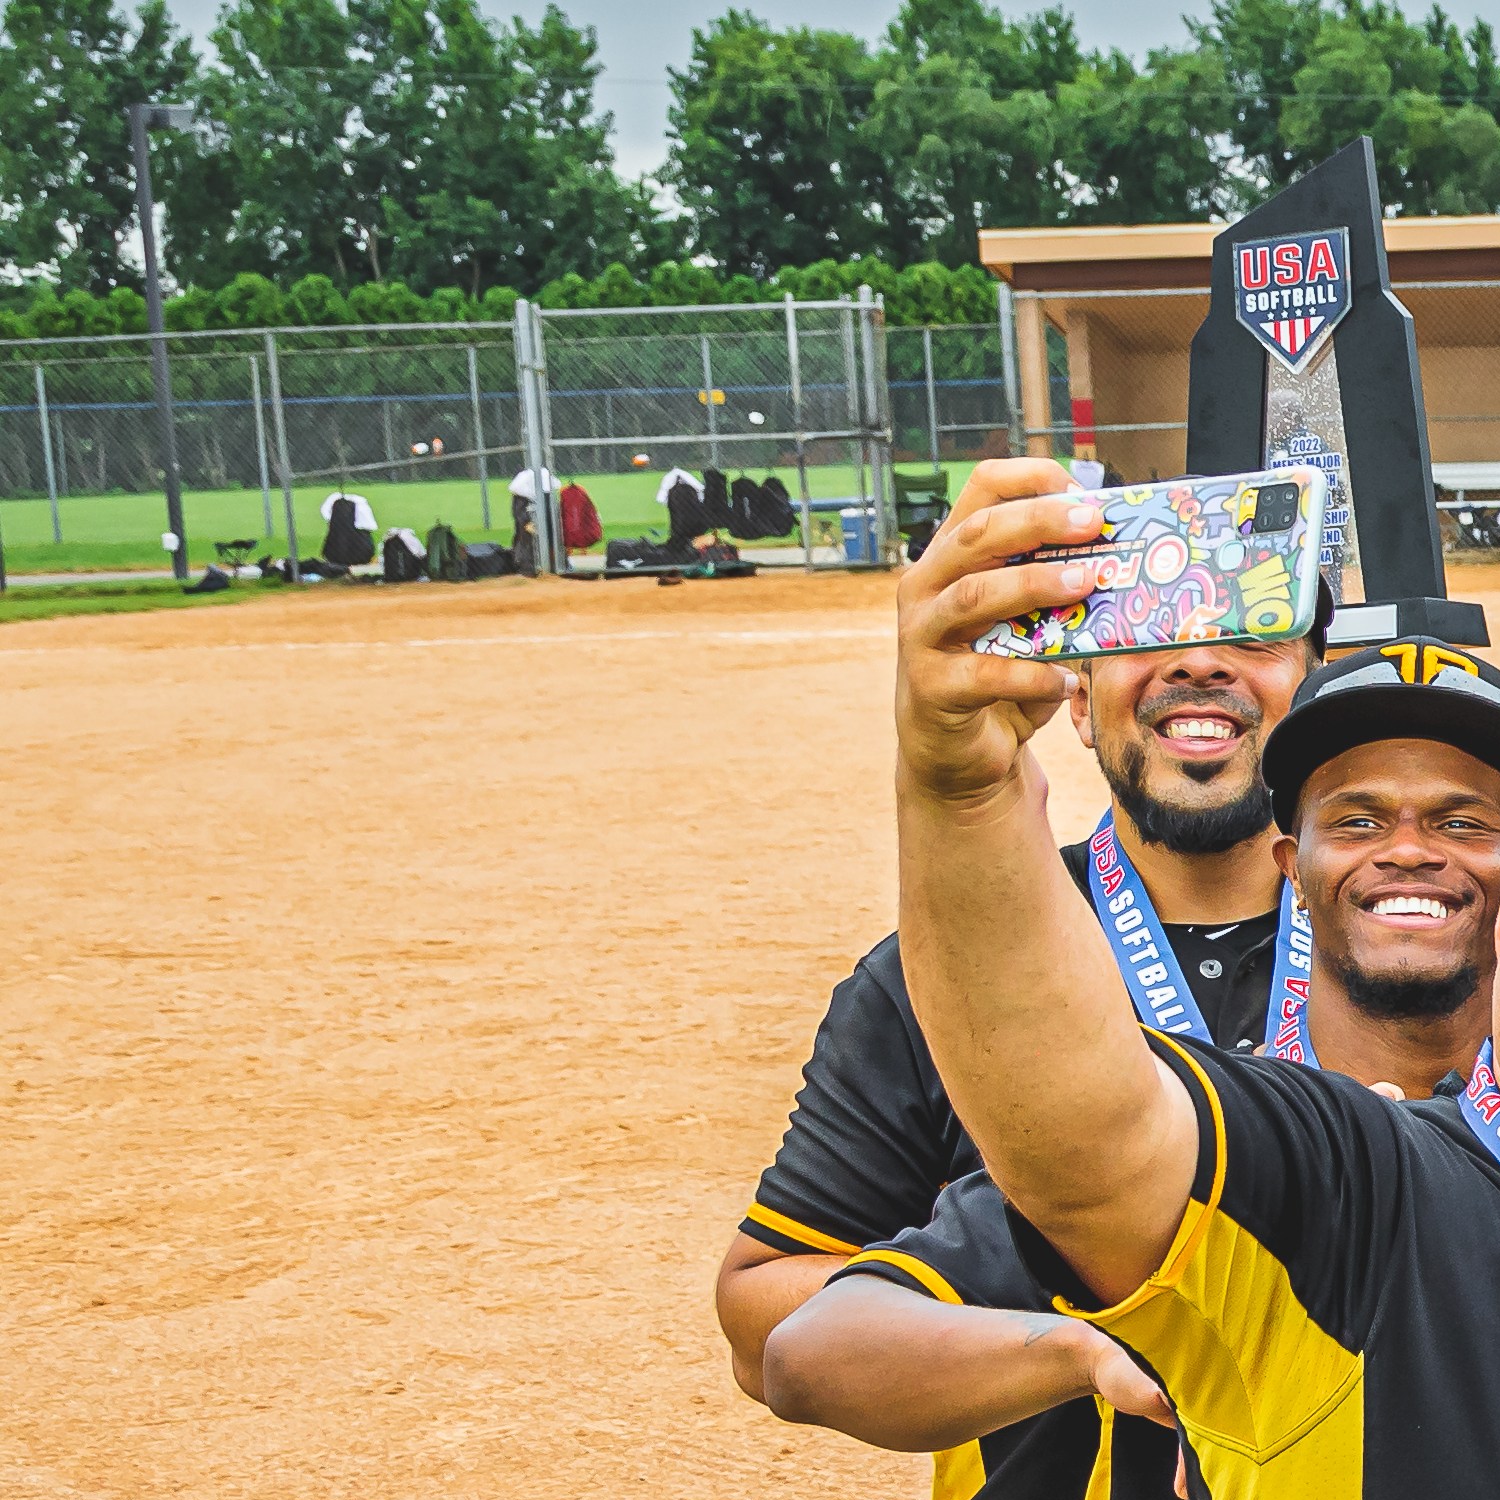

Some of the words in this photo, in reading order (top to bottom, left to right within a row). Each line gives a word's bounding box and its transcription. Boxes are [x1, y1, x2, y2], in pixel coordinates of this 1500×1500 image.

[1240, 239, 1339, 290] USA
[1245, 284, 1338, 313] SOFTBALL
[1291, 438, 1319, 453] 2022
